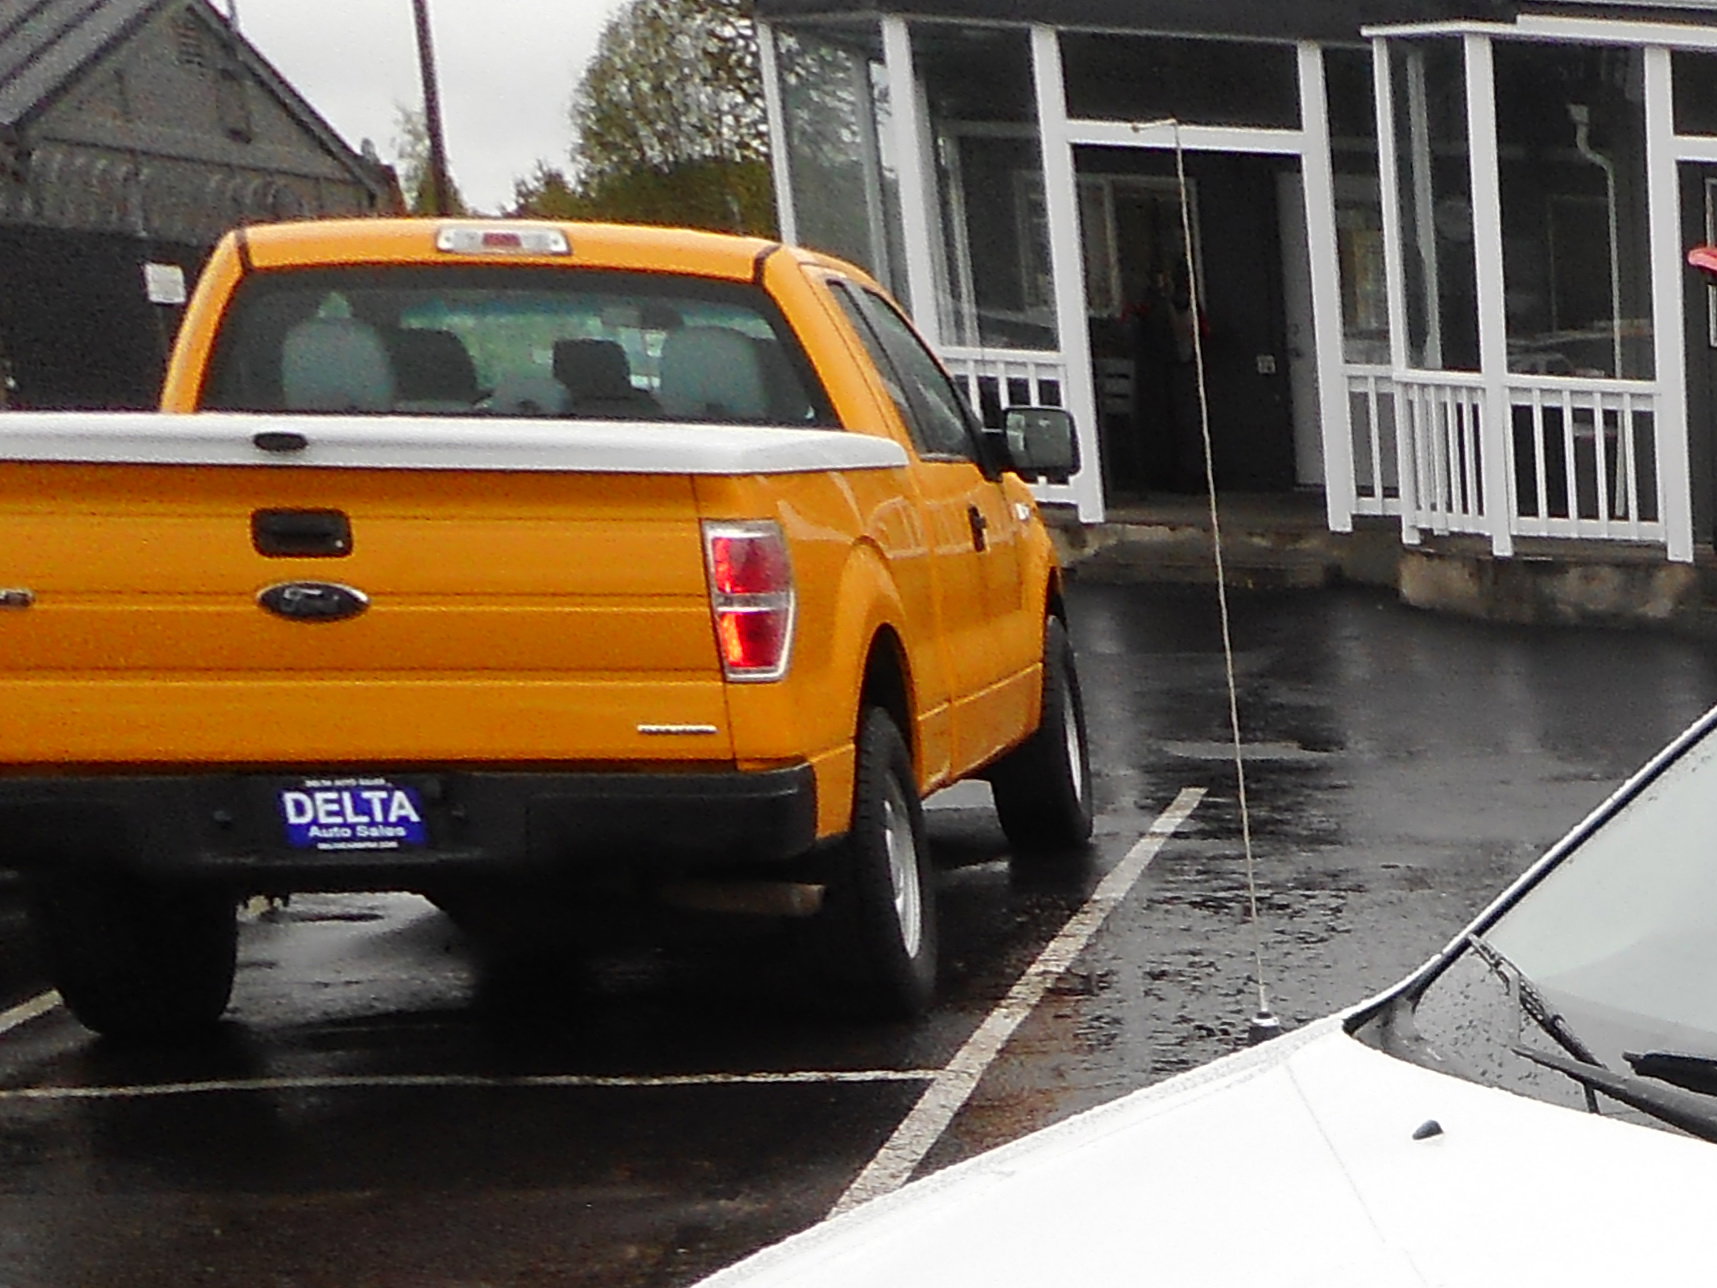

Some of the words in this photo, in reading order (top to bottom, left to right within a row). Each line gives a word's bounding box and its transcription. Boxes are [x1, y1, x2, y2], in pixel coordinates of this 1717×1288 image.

[283, 791, 421, 824] DELTA
[308, 825, 352, 838] Auto
[356, 825, 407, 837] Sales
